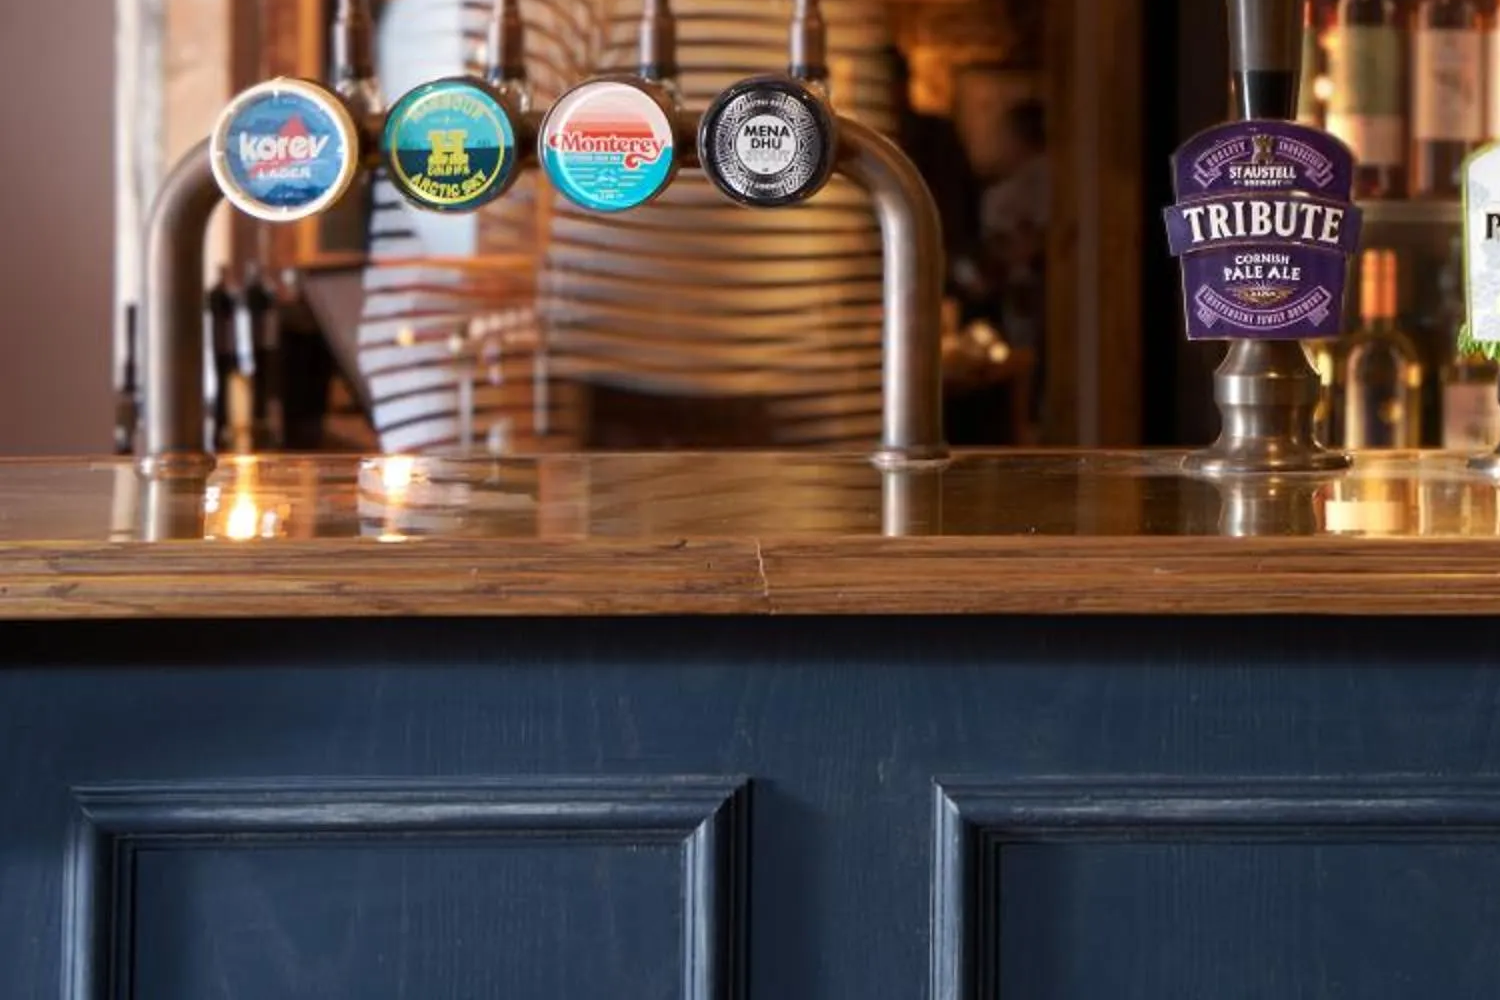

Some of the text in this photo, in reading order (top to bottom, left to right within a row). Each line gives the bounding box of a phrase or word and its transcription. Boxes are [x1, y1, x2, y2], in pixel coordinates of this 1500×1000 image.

[743, 125, 791, 137] MENA
[239, 131, 330, 162] korev
[549, 131, 665, 169] Monterey
[751, 138, 782, 150] DHU
[1243, 165, 1297, 180] AUSTELL
[1182, 200, 1345, 244] TRIBUTE
[1234, 252, 1290, 265] CORNISH
[1223, 265, 1301, 281] PALE ALE
